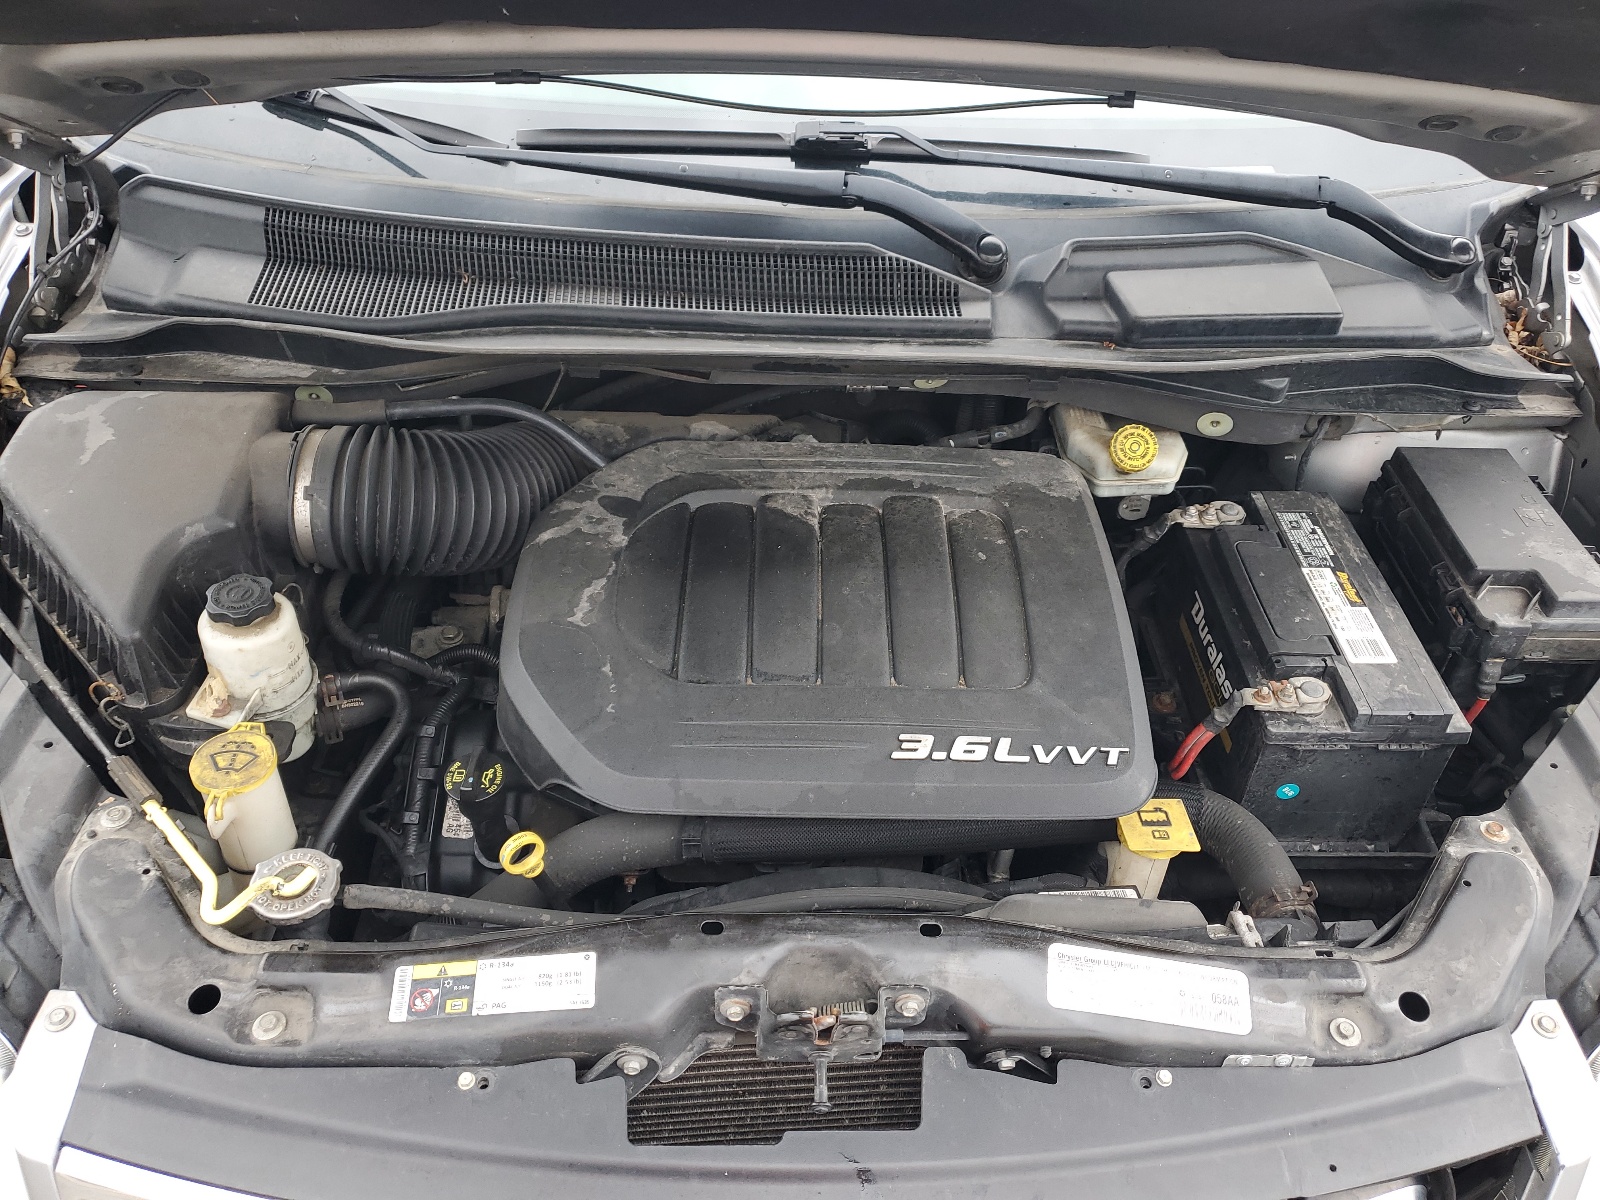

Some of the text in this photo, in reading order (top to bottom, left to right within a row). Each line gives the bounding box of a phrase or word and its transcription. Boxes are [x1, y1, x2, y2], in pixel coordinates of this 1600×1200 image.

[1191, 590, 1234, 700] Duralas
[1208, 668, 1223, 706] GOL
[1032, 744, 1130, 766] VVT
[486, 763, 503, 793] ENGINE OIL
[1084, 955, 1102, 966] Group
